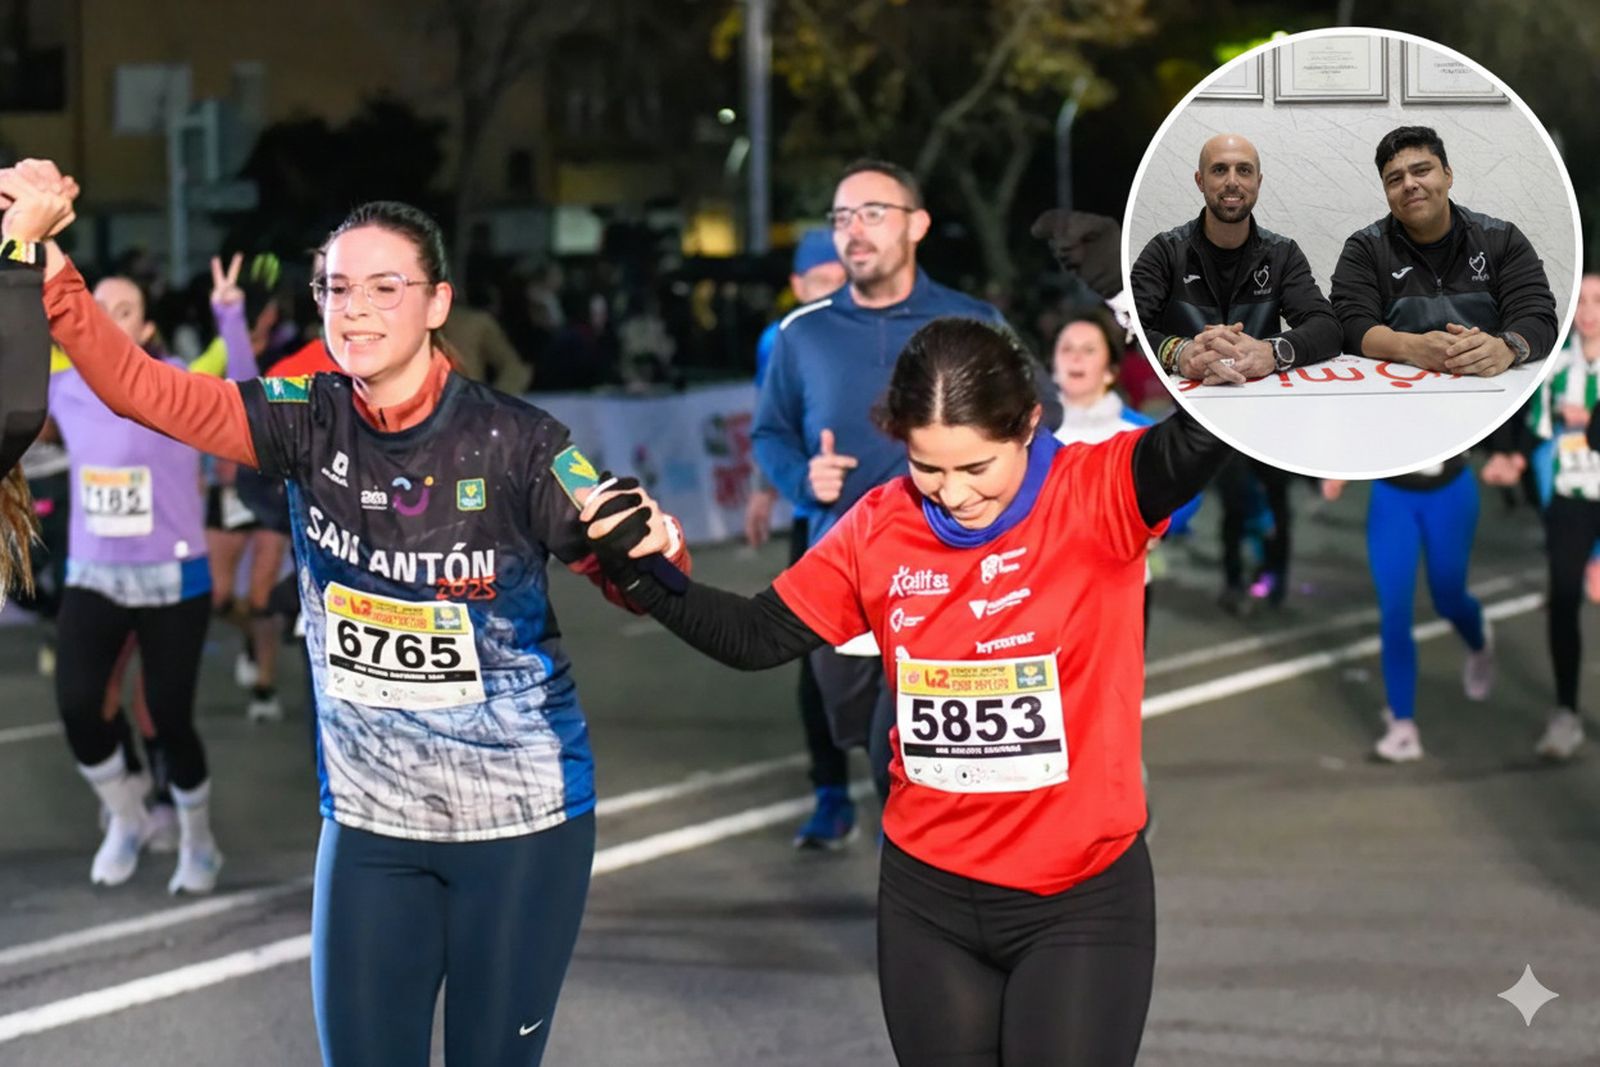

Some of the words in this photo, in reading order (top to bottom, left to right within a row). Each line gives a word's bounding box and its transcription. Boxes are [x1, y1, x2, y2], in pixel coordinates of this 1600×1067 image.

[306, 506, 360, 565] SAN
[368, 542, 496, 585] ANTÓN
[337, 619, 461, 669] 6765
[912, 695, 1046, 742] 5853
